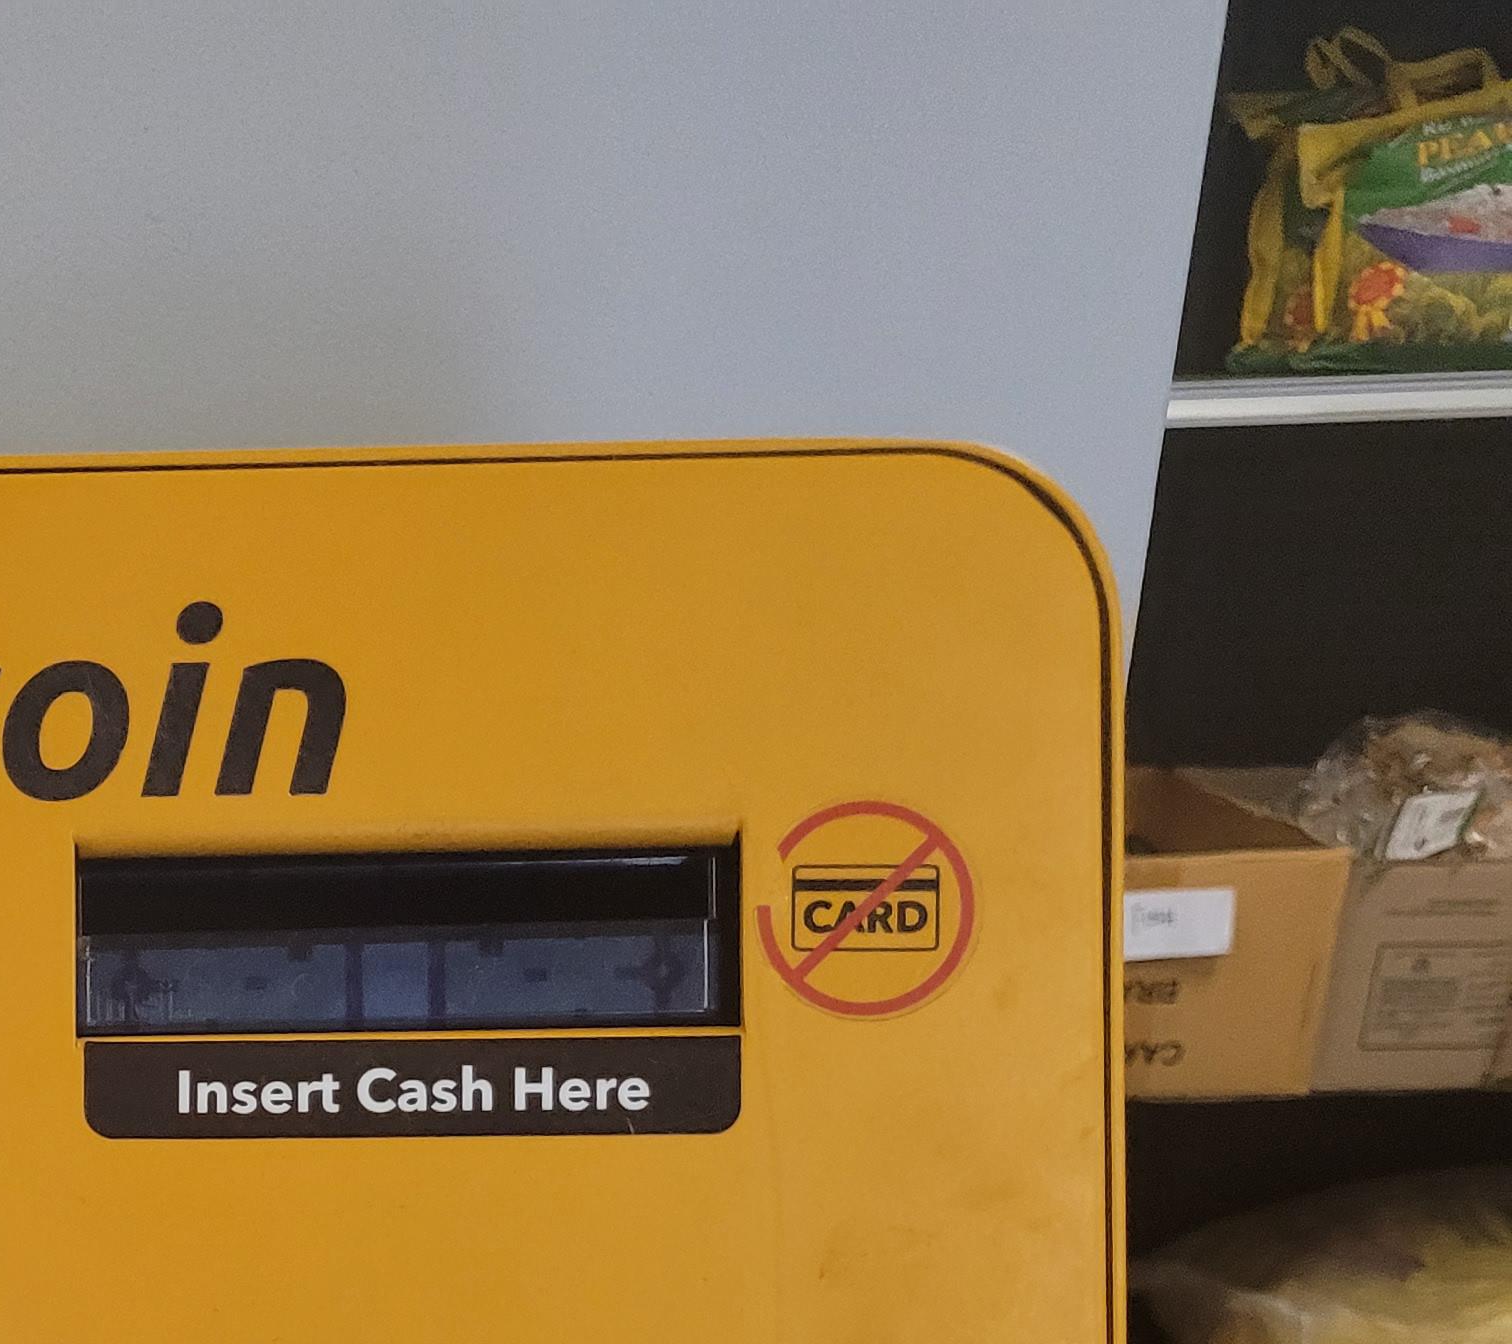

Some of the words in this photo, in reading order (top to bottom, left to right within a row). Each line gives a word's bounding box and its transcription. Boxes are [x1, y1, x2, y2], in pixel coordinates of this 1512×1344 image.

[803, 900, 928, 933] CARD
[179, 1070, 339, 1114] Insert
[357, 1065, 492, 1113] Cash
[515, 1067, 650, 1111] Here
